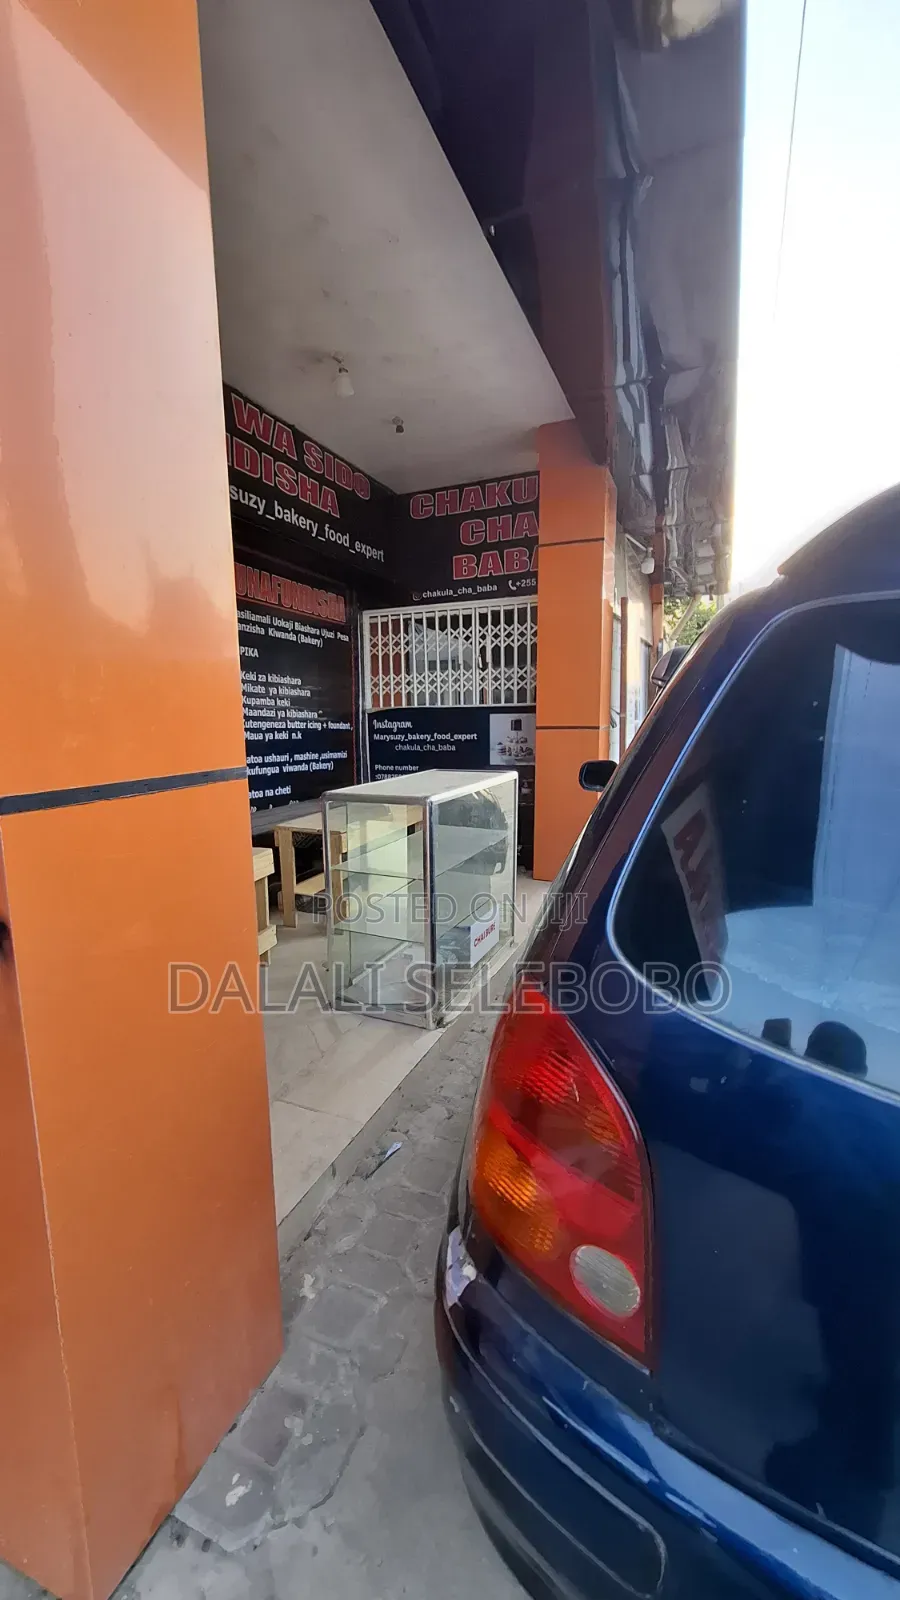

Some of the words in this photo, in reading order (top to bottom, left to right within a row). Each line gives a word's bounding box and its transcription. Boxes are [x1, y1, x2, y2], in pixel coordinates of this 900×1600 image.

[231, 393, 298, 461] WA
[303, 440, 371, 500] SIDO
[226, 433, 341, 518] DISHA
[409, 475, 539, 520] CHAKU
[229, 485, 385, 563] suzy_bakery_food_expert
[460, 511, 539, 546] CHA
[422, 583, 498, 599] chakula_cha_baba
[294, 621, 320, 636] Biashara
[297, 633, 323, 648] (Bakery)
[240, 645, 259, 658] PIKA
[267, 672, 302, 686] kibiashara
[279, 684, 311, 697] kibiashara
[286, 709, 318, 719] kibiashara
[373, 719, 413, 733] Instagram
[274, 730, 289, 741] keki
